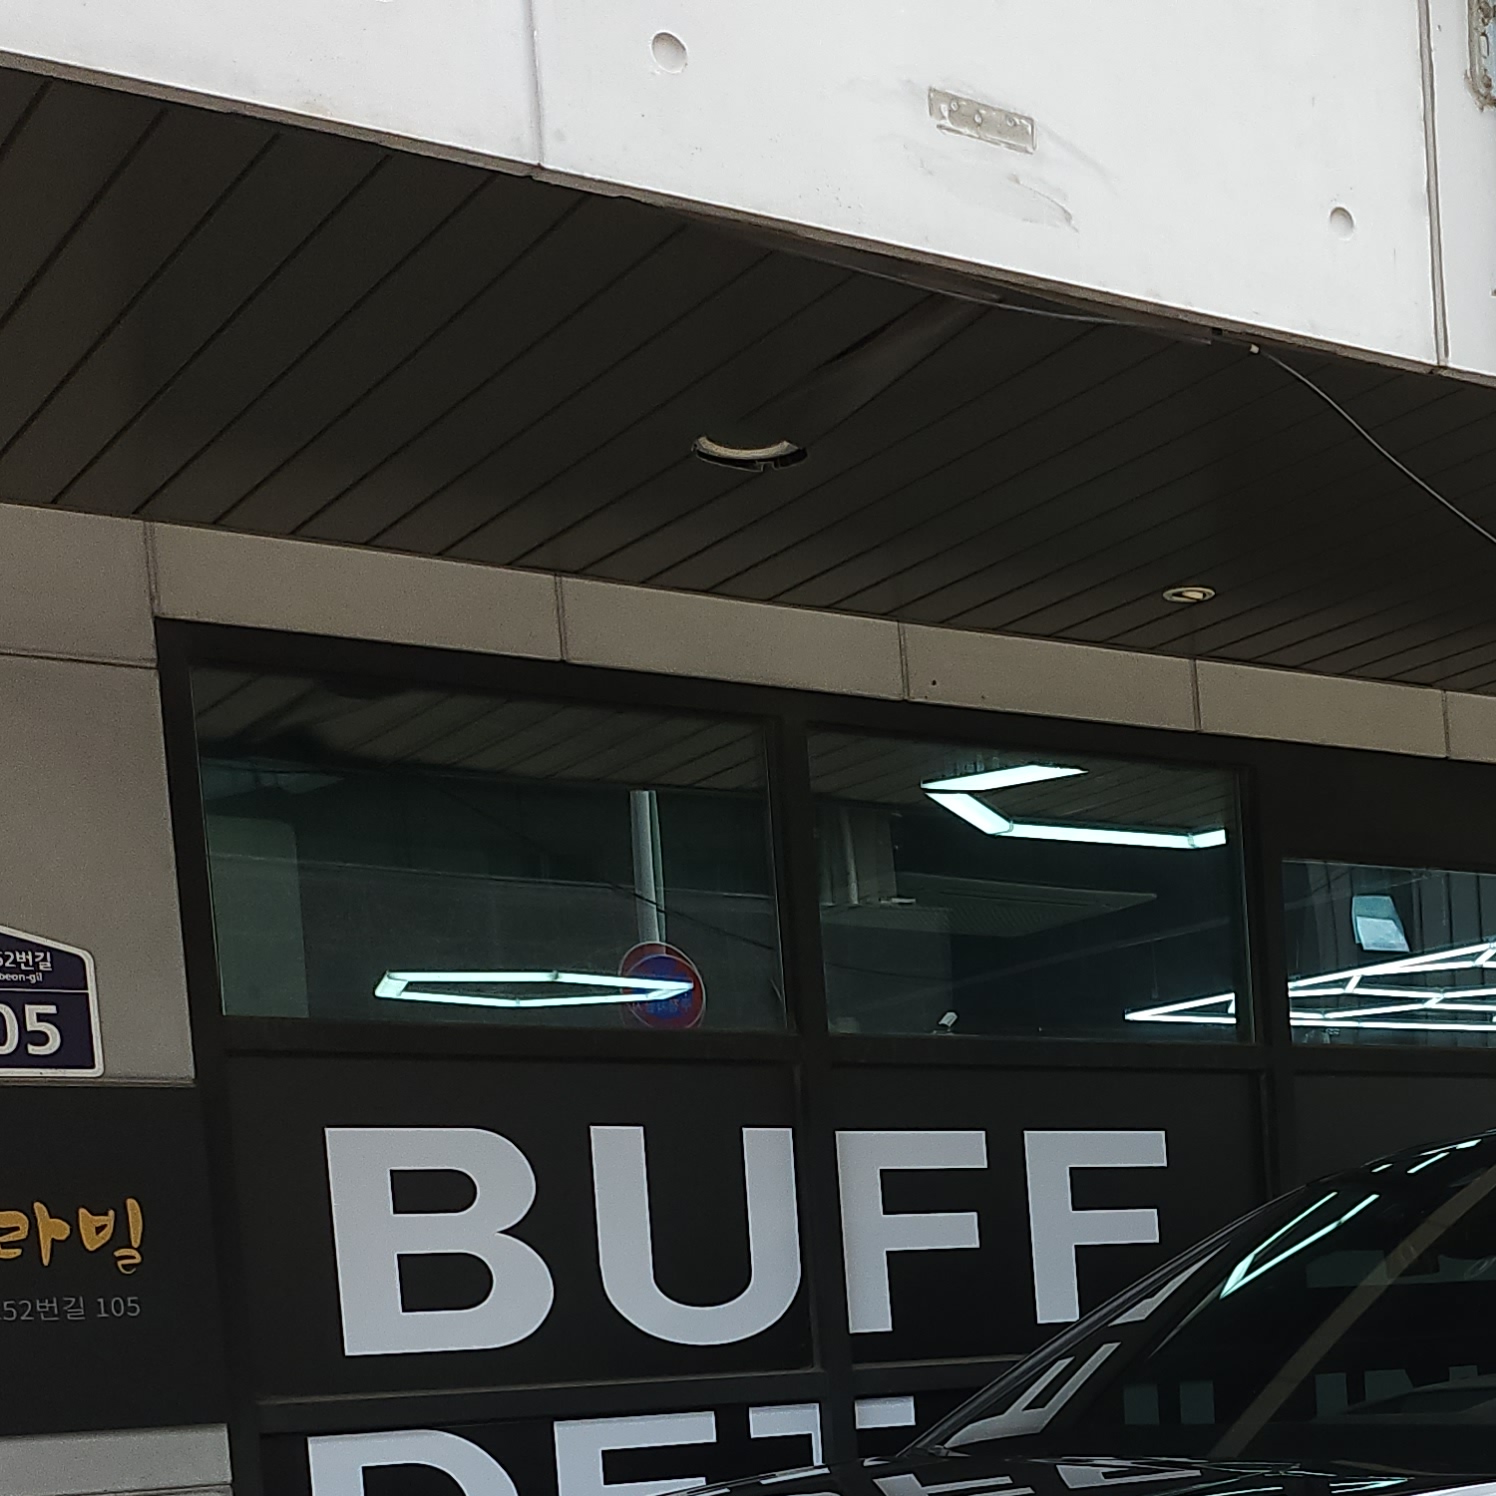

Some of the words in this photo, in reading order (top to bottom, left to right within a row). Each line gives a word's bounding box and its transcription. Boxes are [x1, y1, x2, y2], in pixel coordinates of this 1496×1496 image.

[324, 1125, 1168, 1357] BUFF
[0, 1296, 86, 1321] 52번길
[97, 1296, 141, 1318] 105
